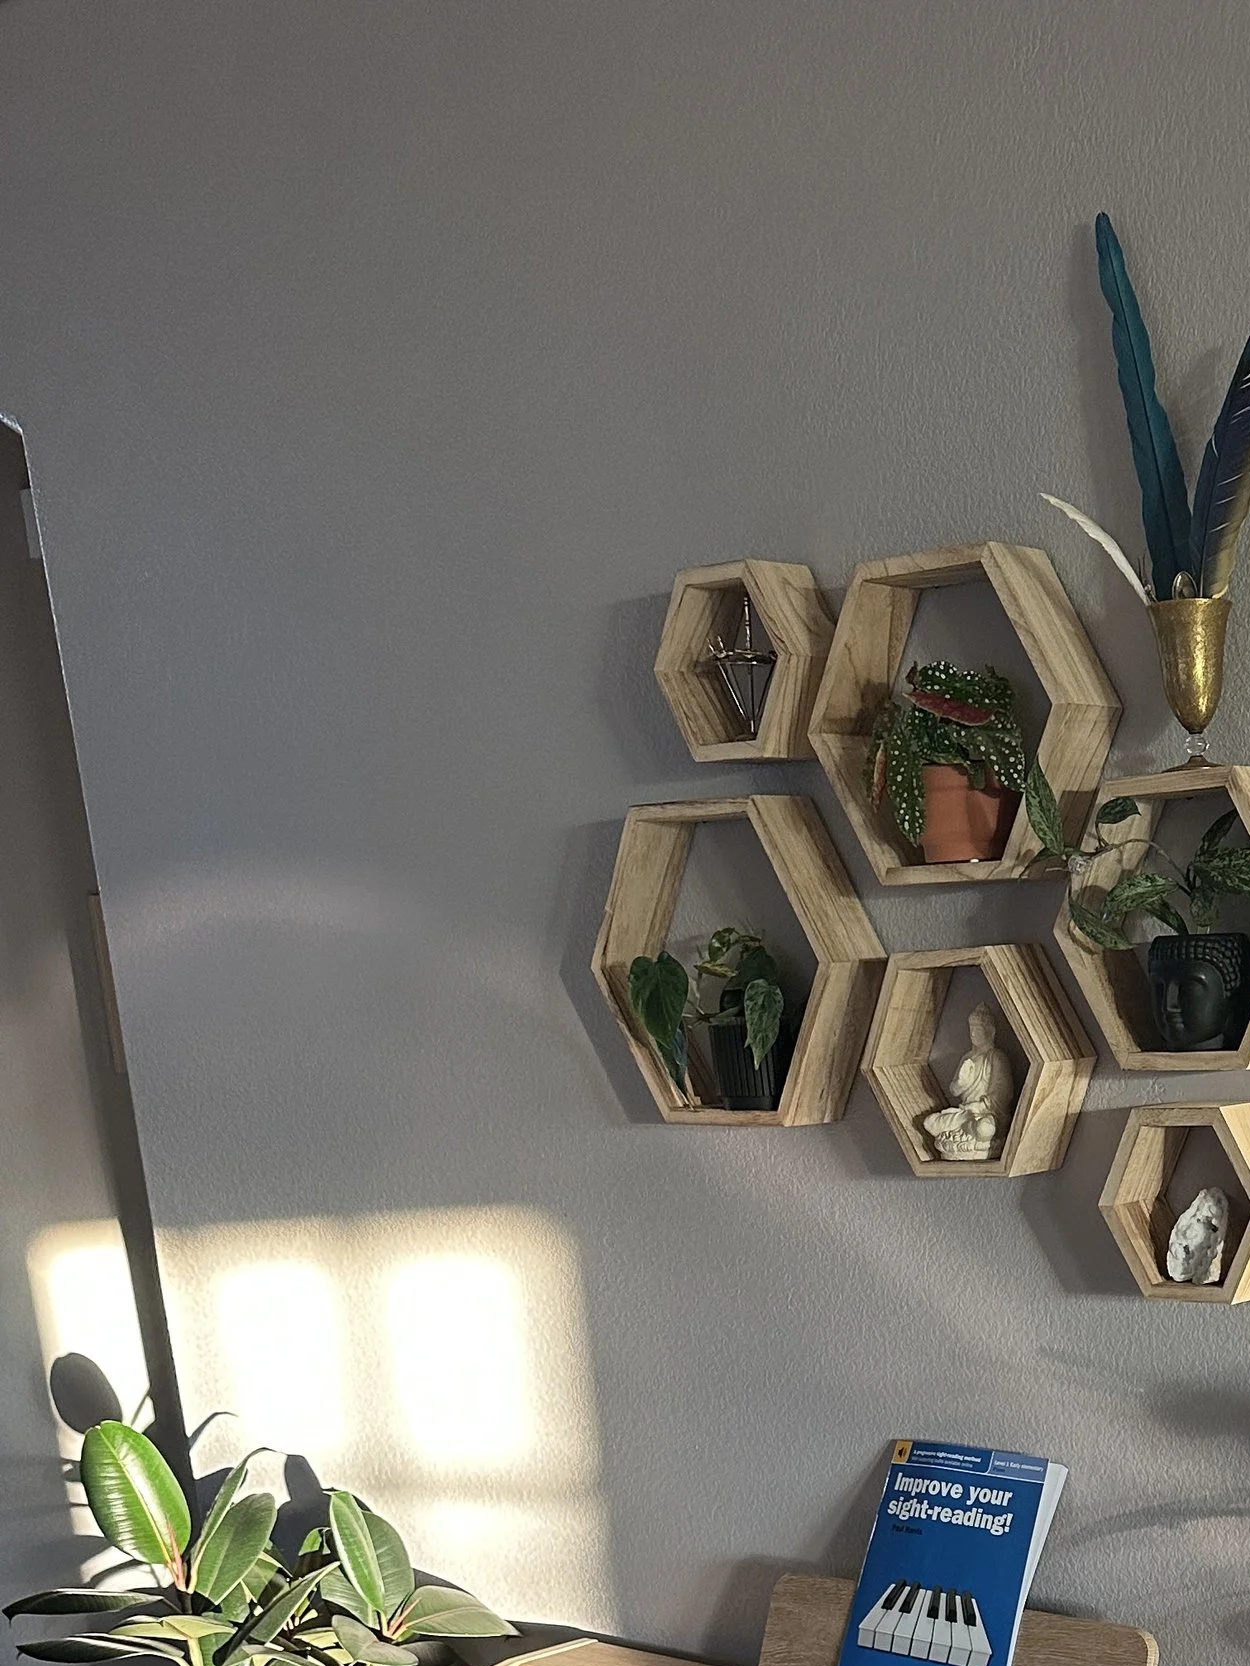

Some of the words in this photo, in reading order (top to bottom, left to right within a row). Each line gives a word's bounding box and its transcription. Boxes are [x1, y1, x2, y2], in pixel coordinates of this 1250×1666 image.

[894, 1472, 963, 1499] Improve
[965, 1485, 1014, 1507] your
[887, 1496, 1014, 1536] sight-reading!
